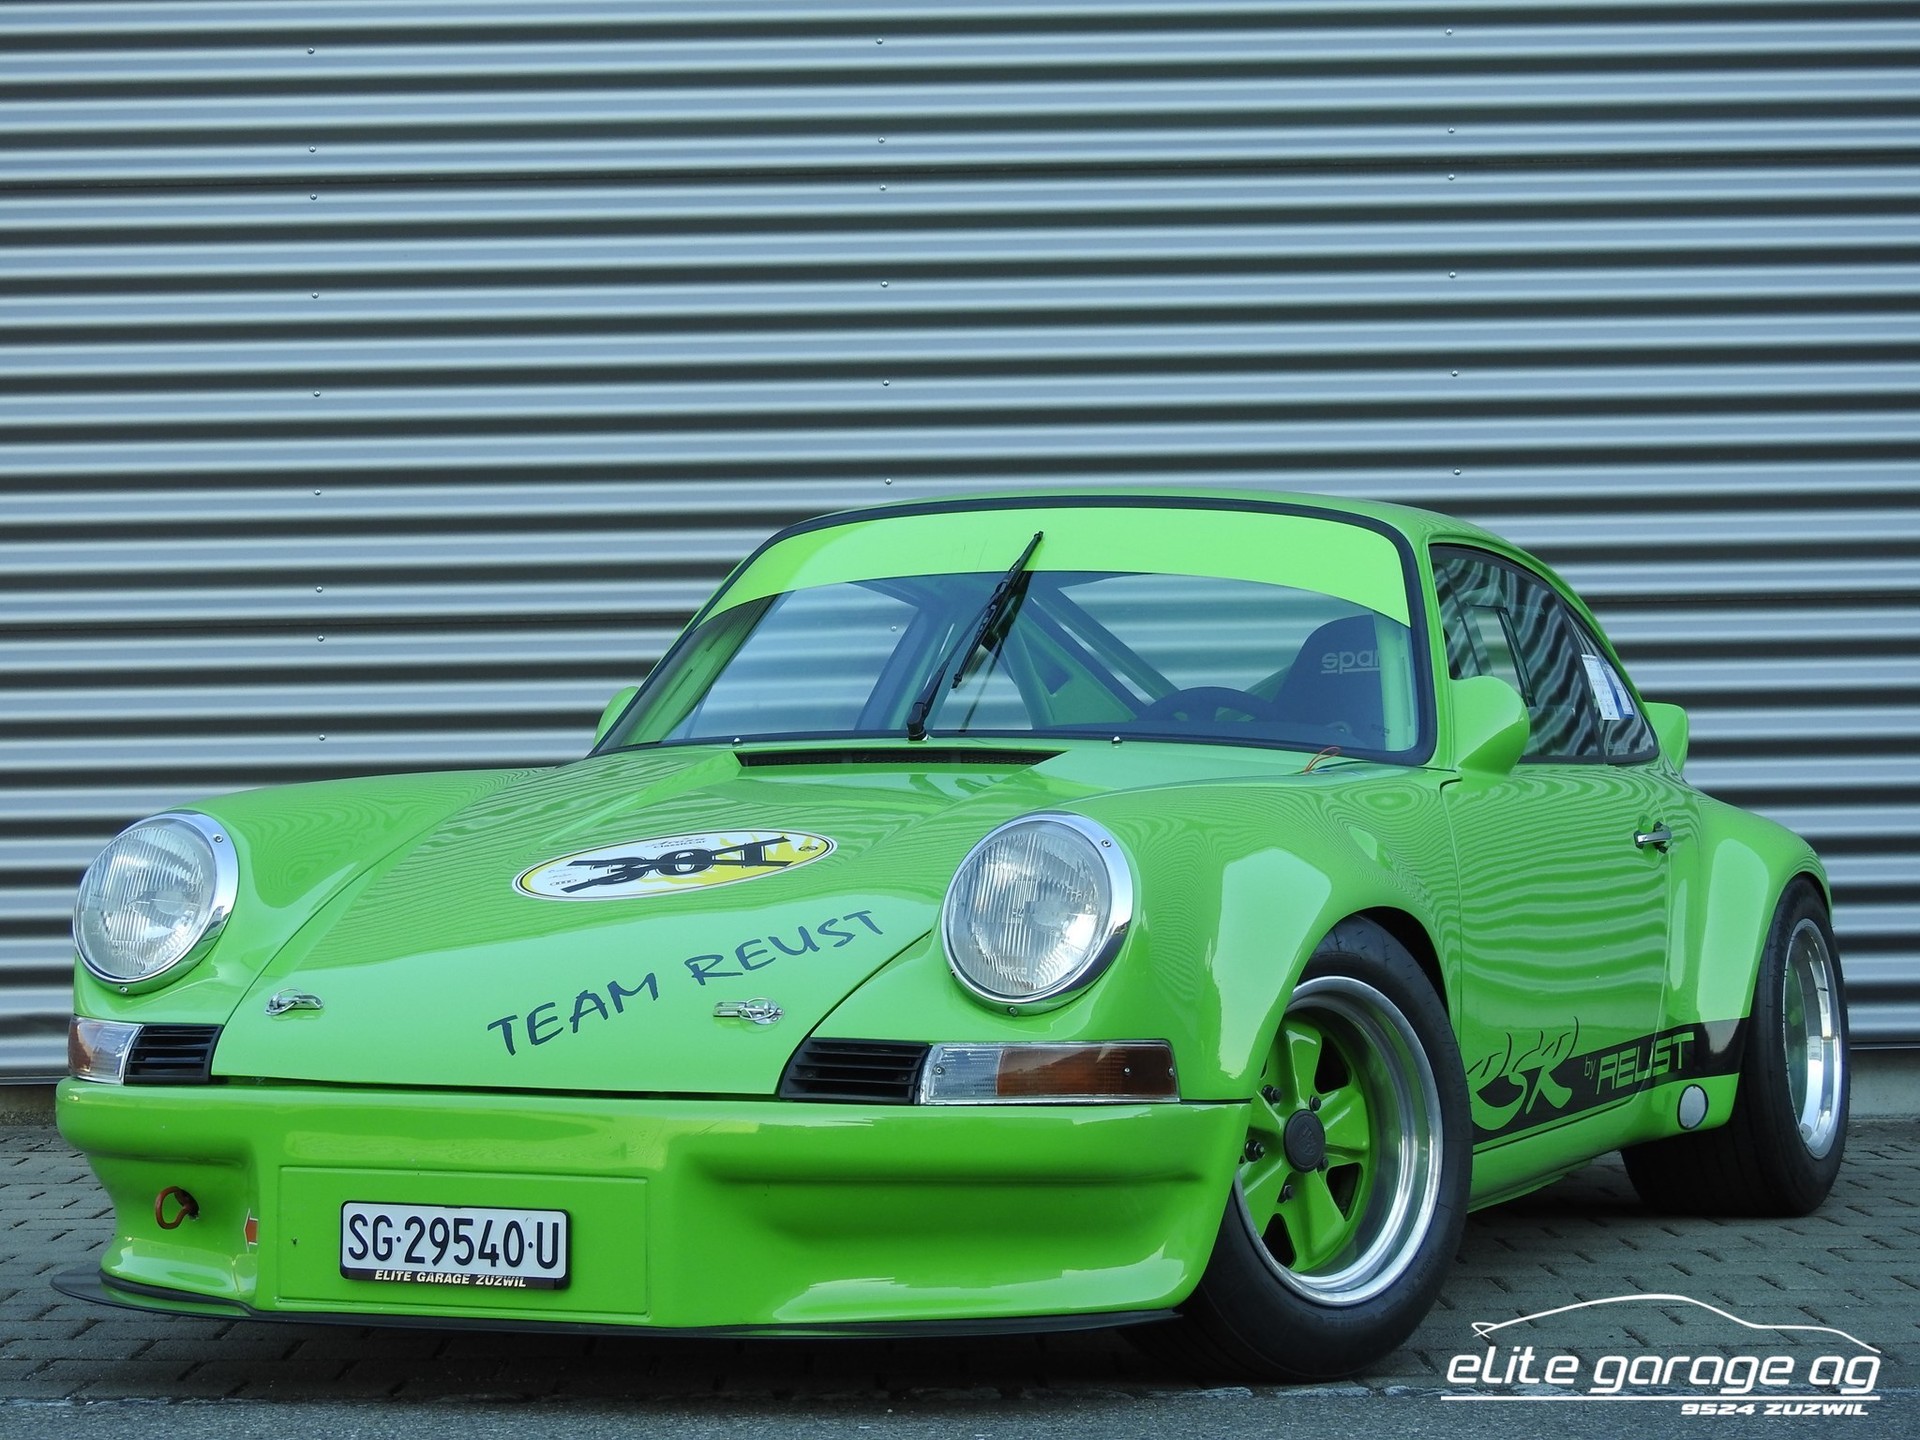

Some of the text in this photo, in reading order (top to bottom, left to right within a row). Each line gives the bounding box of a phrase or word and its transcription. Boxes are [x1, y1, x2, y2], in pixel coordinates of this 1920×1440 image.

[487, 910, 884, 1056] TEAM REUST
[1584, 1056, 1597, 1080] by
[1597, 1032, 1695, 1095] REUST
[374, 1270, 527, 1287] ELITE GARAGE ZUZWIL
